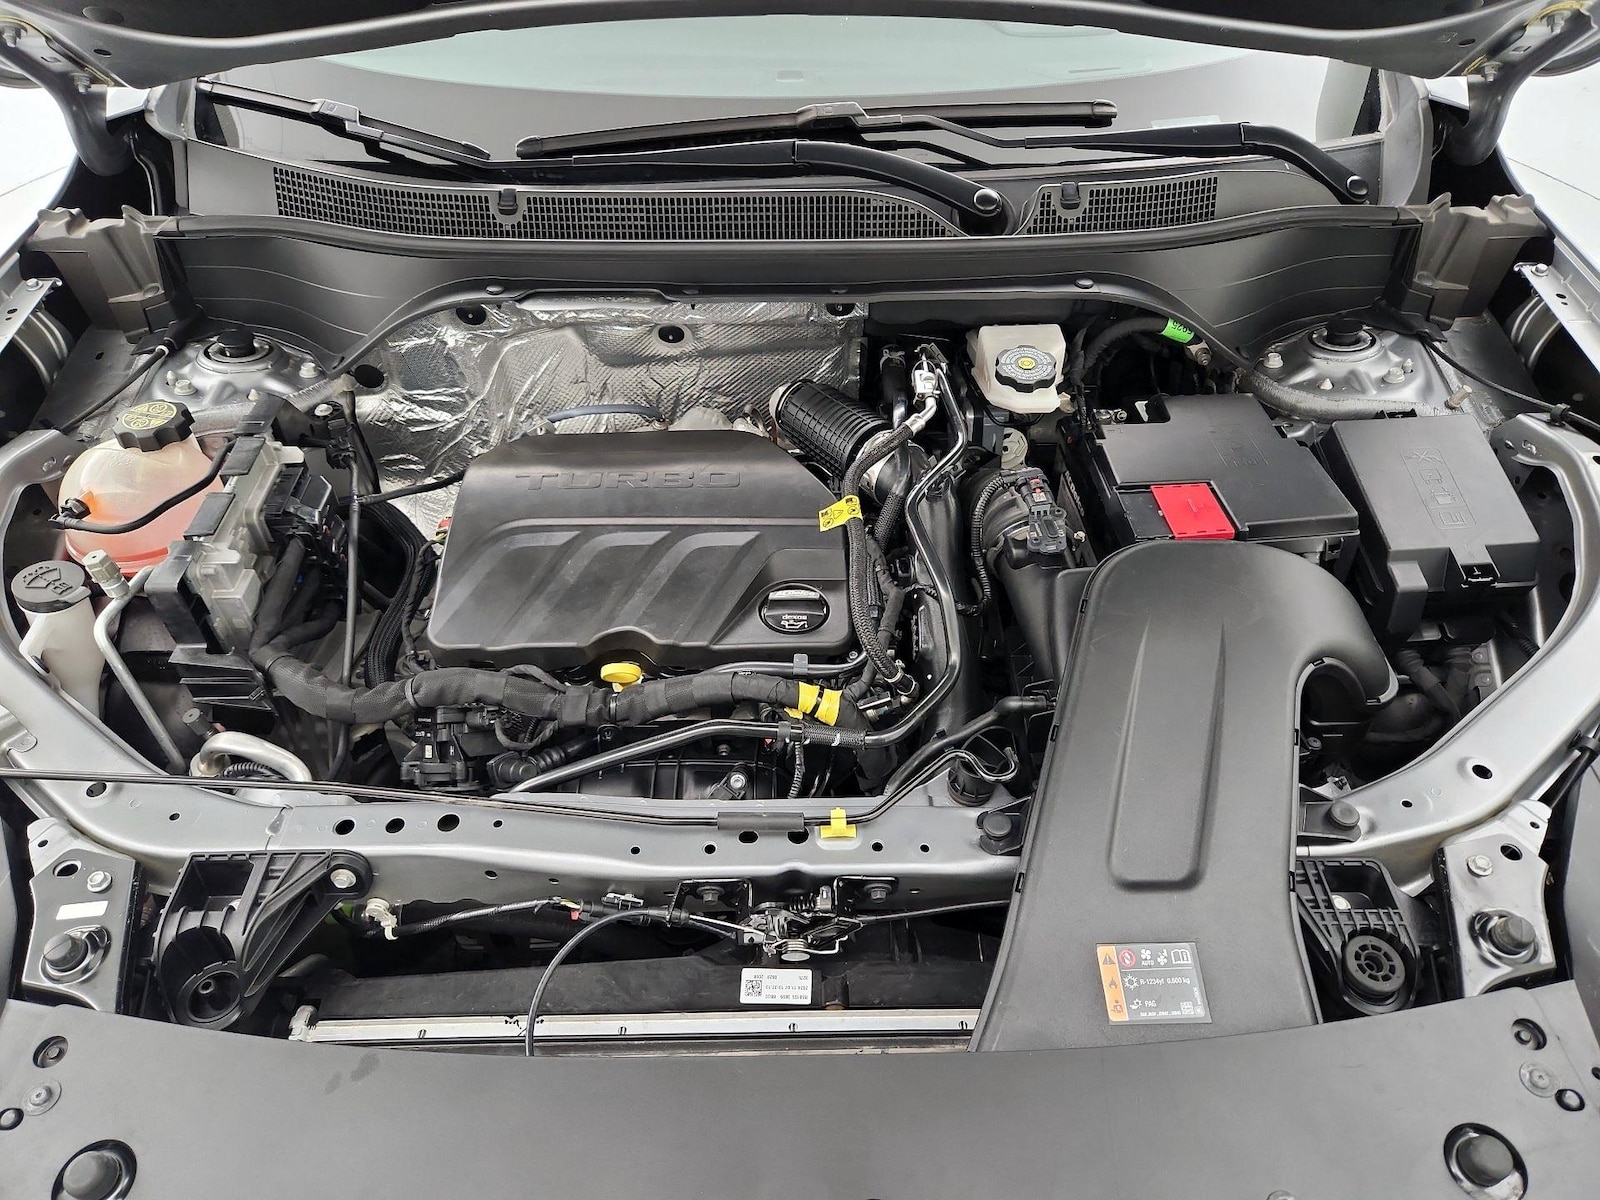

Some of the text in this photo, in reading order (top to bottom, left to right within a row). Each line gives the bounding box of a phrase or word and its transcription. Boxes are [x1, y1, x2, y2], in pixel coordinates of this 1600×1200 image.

[515, 471, 741, 490] TURBO
[1140, 978, 1164, 986] R-1234yf
[1144, 1000, 1157, 1008] PAG
